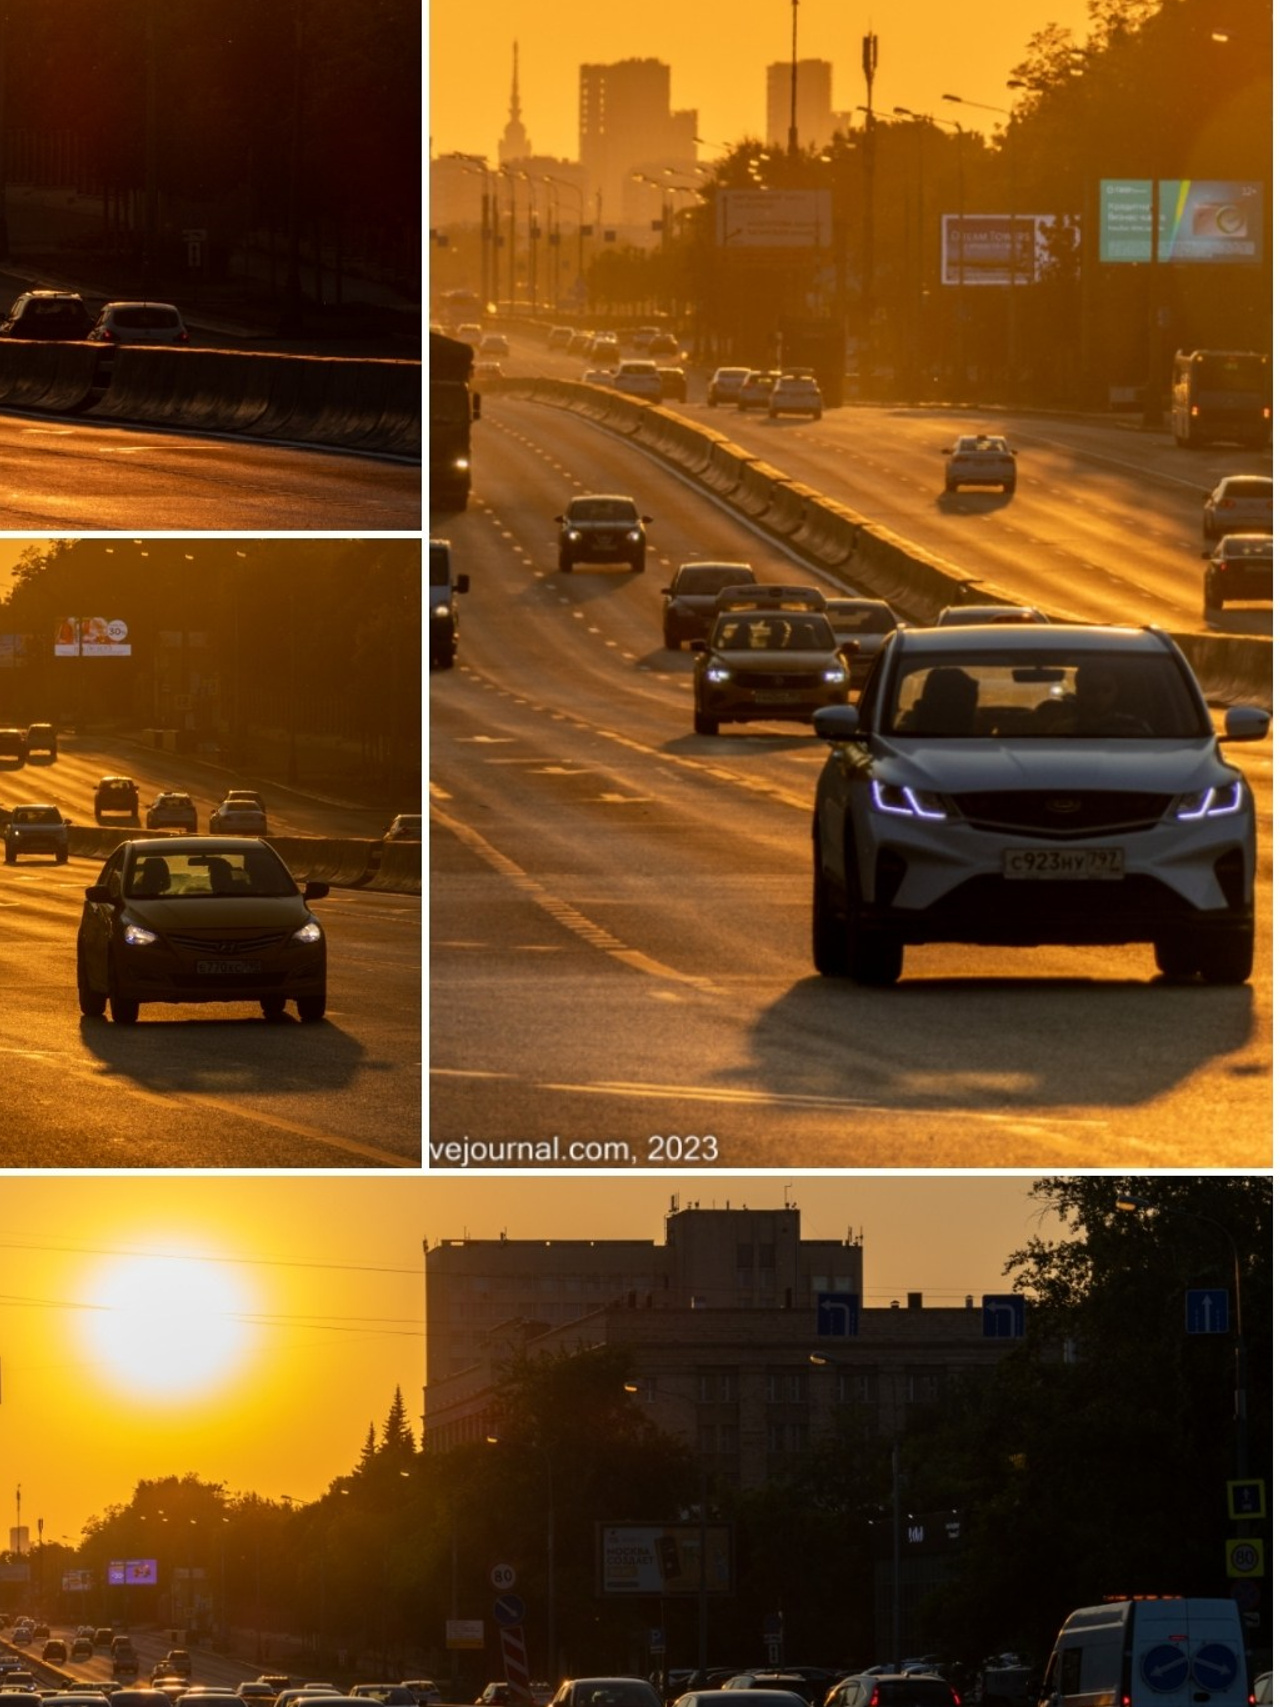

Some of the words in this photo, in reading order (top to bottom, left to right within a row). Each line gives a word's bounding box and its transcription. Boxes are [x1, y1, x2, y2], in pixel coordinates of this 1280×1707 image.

[1011, 852, 1084, 871] С923НУ
[1235, 1549, 1254, 1564] 80
[494, 1570, 512, 1582] 80
